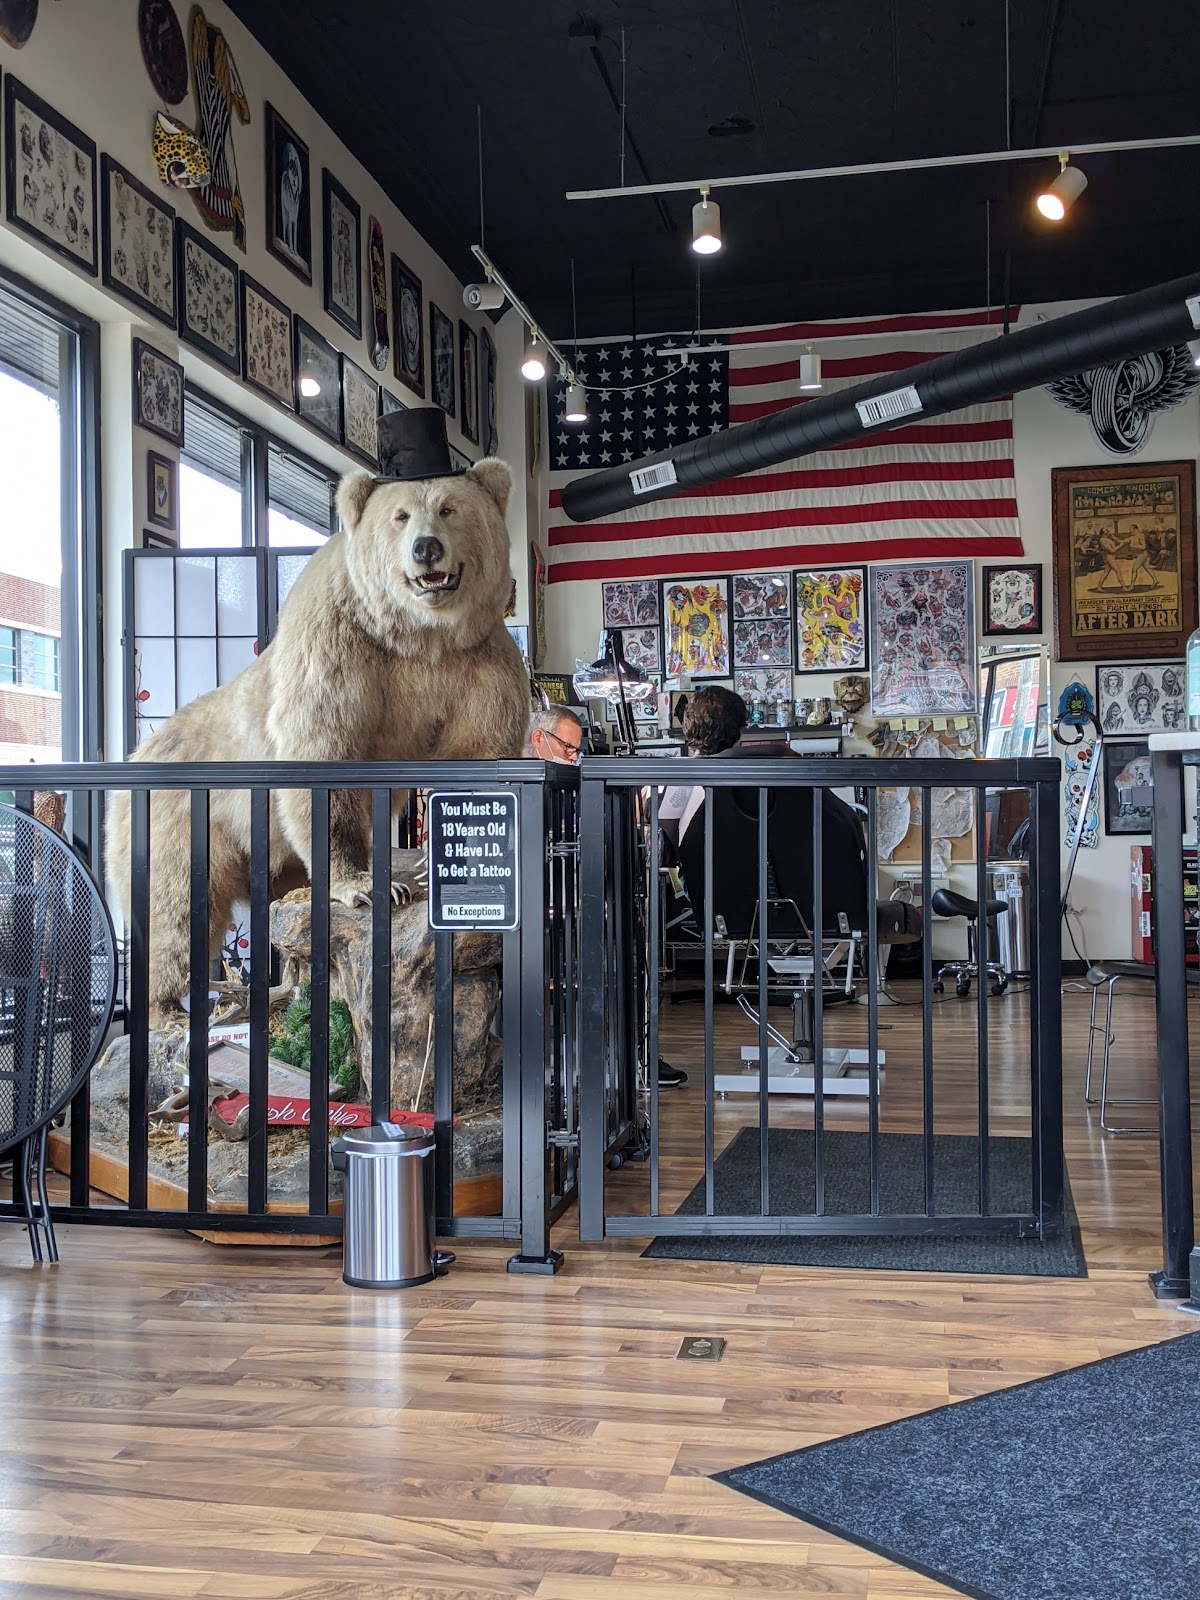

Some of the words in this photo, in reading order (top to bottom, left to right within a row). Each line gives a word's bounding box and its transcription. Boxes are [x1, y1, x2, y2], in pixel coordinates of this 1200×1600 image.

[1087, 486, 1121, 494] COMEDY
[1106, 604, 1129, 612] FIGHT
[1077, 612, 1129, 630] AFTER
[1133, 609, 1178, 628] DARK
[540, 682, 564, 690] PANESE
[440, 802, 461, 816] You
[462, 802, 491, 816] Must
[492, 801, 507, 816] Be
[441, 822, 455, 837] 18
[455, 822, 485, 836] Years
[487, 822, 506, 836] Old
[444, 843, 454, 857] &
[455, 843, 483, 857] Have
[485, 843, 503, 857] I.D.
[437, 864, 449, 877] To
[450, 864, 468, 877] Get
[470, 867, 477, 877] a
[478, 864, 511, 877] Tattoo
[447, 906, 458, 916] No
[459, 906, 502, 918] Exceptions
[222, 1034, 232, 1042] DO
[301, 1103, 358, 1125] Oly
